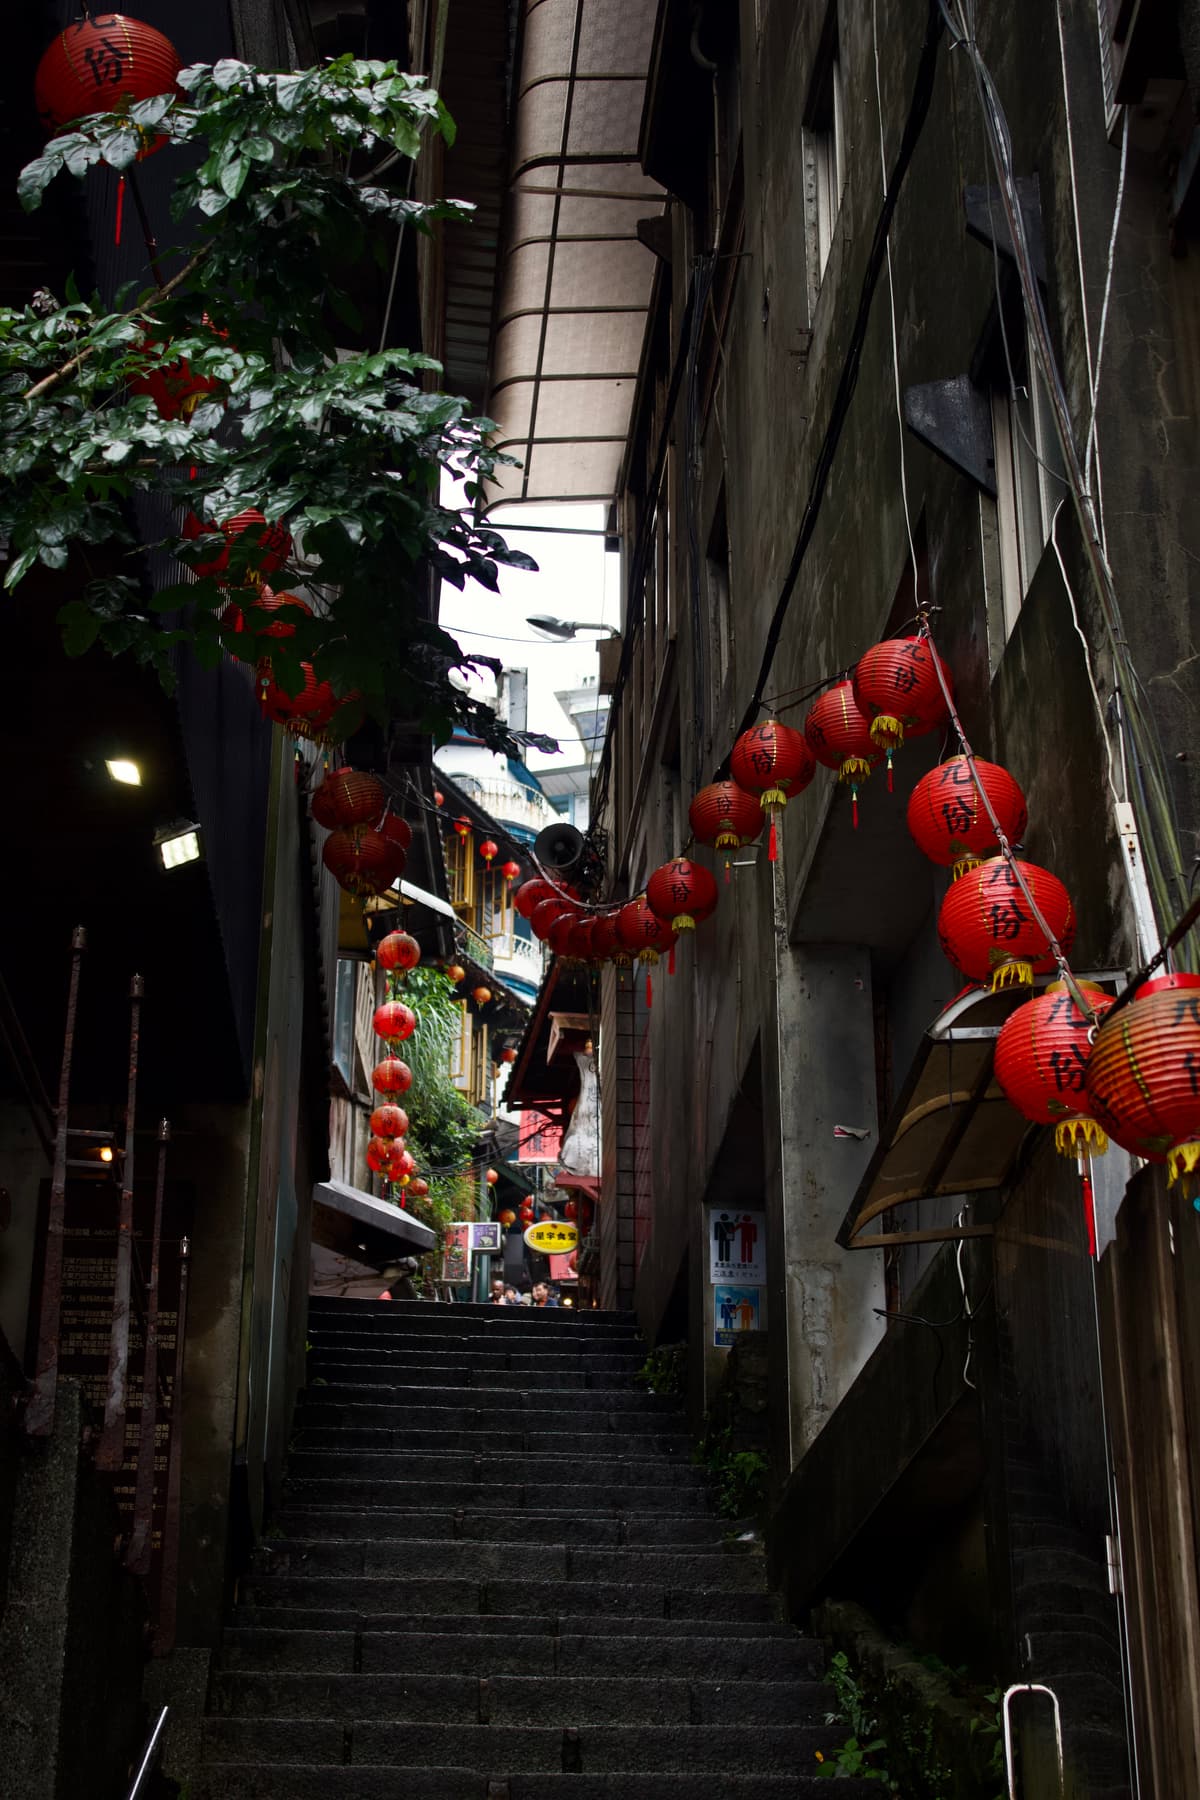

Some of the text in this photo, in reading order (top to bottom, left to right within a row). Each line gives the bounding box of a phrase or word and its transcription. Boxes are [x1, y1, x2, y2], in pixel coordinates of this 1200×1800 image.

[72, 16, 128, 85] 九份
[895, 643, 925, 694] 九份
[750, 726, 774, 776] 九份
[940, 764, 975, 834] 九份
[670, 863, 691, 903] 九份
[988, 864, 1030, 939] 九份
[1046, 995, 1091, 1093] 九份
